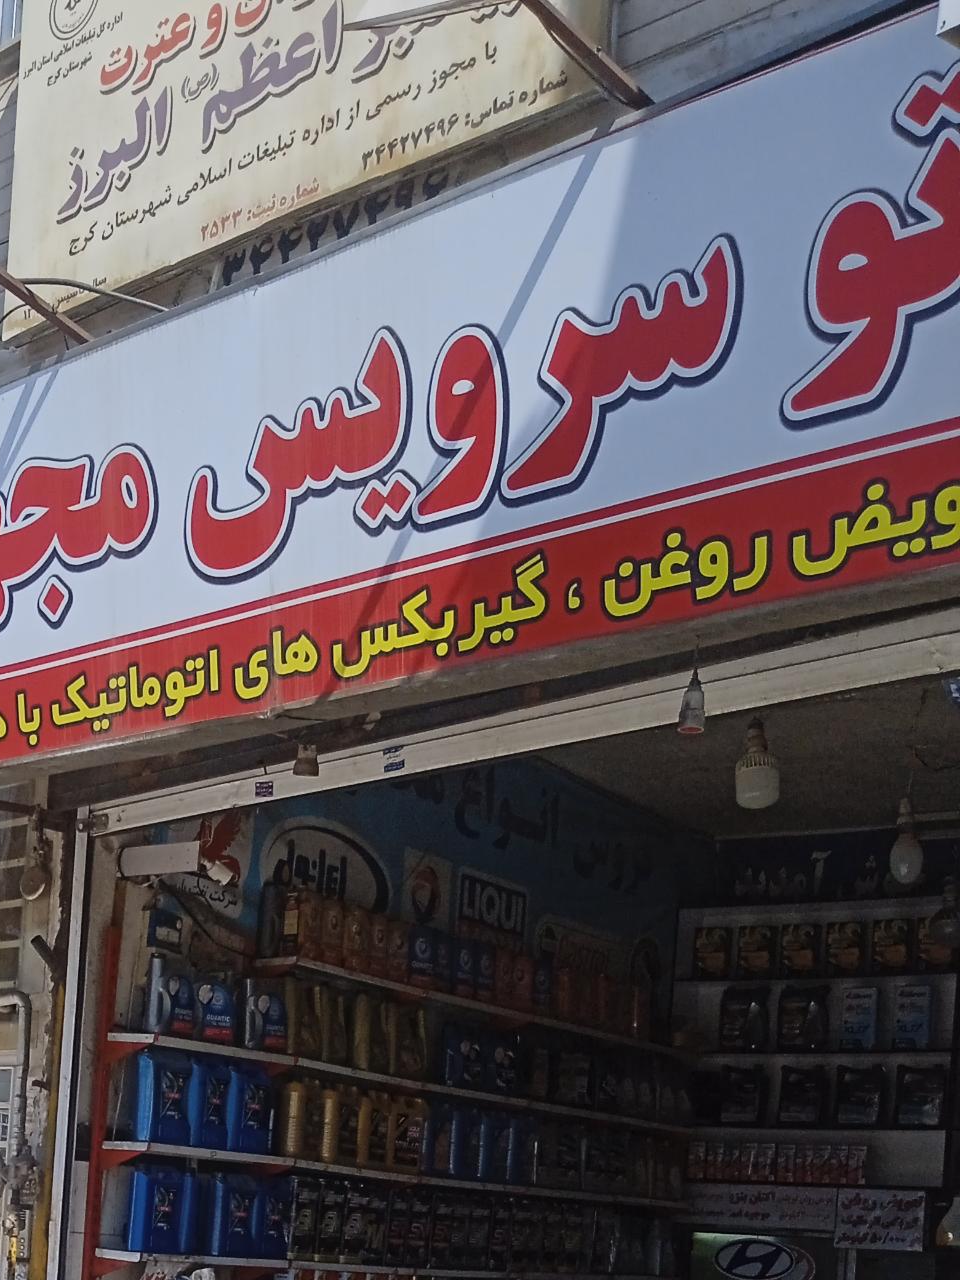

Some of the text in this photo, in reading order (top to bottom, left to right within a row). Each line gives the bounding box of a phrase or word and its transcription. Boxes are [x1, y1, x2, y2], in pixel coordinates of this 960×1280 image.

[47, 52, 93, 87] شهرستان کرج
[99, 11, 196, 95] عترت
[485, 41, 497, 64] با
[427, 57, 476, 93] مجوز
[344, 100, 360, 130] از
[362, 69, 569, 171] شماره تماس: ۳۴۴۲۷۴۹۶
[366, 83, 421, 121] رسمی
[237, 129, 296, 170] تبلیغات
[302, 109, 340, 146] اداره
[56, 86, 173, 225] البرز
[177, 158, 232, 205] اسلامی
[279, 177, 320, 210] شماره
[101, 185, 173, 241] شهرستان
[201, 208, 243, 242] ۲۵۳۳
[69, 221, 98, 256] کرج
[186, 234, 743, 585] سرویس
[602, 530, 768, 618] روغن
[234, 629, 318, 700] های
[51, 648, 221, 734] اتوماتیک
[17, 695, 41, 747] با
